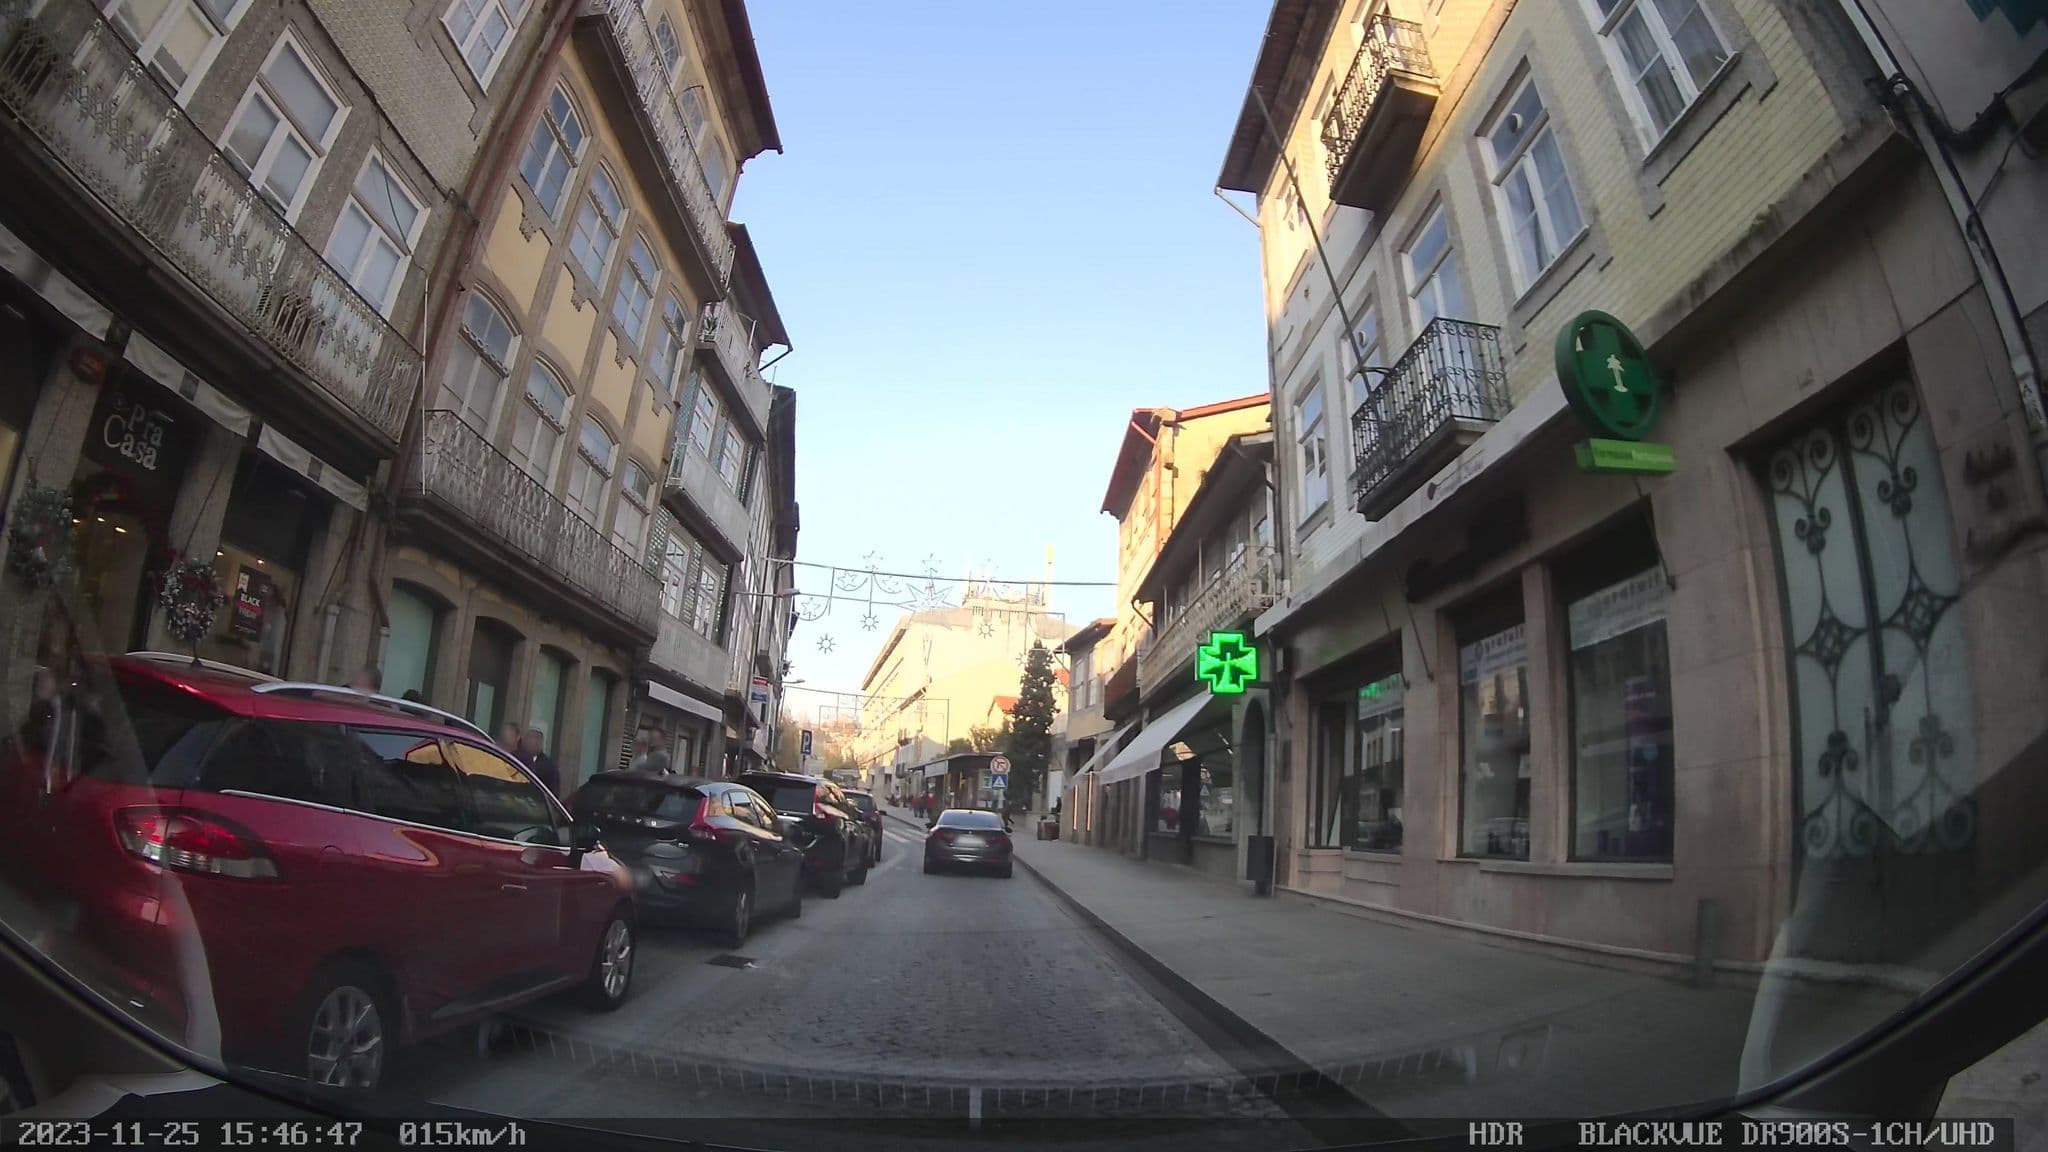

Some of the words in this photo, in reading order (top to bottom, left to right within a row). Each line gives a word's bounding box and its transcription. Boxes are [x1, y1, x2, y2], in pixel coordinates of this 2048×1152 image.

[128, 402, 164, 448] Pra
[103, 414, 158, 471] Casa
[240, 593, 261, 607] BLACK
[803, 732, 811, 753] P
